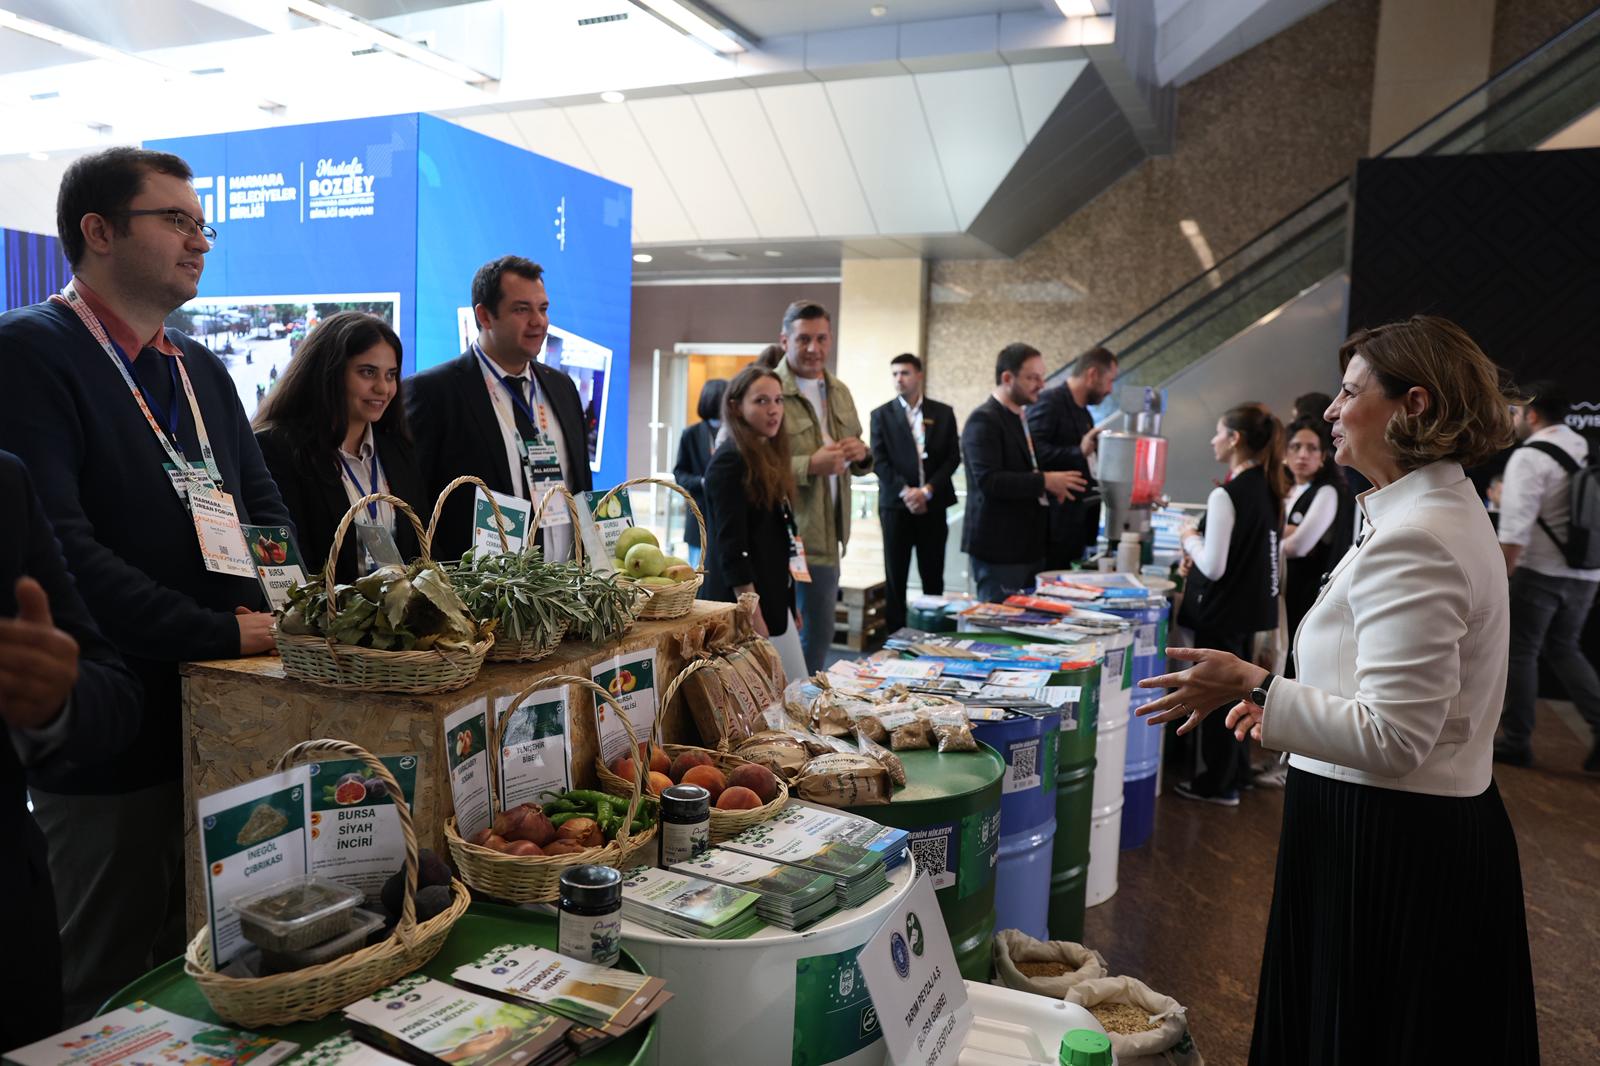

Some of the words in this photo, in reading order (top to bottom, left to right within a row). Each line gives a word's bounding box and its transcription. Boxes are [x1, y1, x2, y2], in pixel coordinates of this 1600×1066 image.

[229, 173, 285, 190] MARMARA
[309, 175, 375, 197] BOZBEY
[229, 187, 297, 205] BELEDİYELER
[229, 201, 265, 220] BİRLİĞİ
[193, 496, 222, 508] MARMARA
[194, 502, 214, 513] URBAN
[214, 507, 235, 517] FORUM
[1270, 529, 1280, 597] Volunteer
[267, 568, 286, 577] BURSA
[338, 808, 376, 821] BURSA
[339, 822, 373, 836] SİYAH
[907, 829, 927, 841] BENİM
[247, 842, 278, 861] İNEGÖL
[337, 836, 373, 850] İNCİRİ
[243, 853, 284, 878] ÇIBRIKASI
[539, 969, 571, 992] HİZMETİ
[905, 1002, 920, 1028] TARIM
[917, 978, 935, 1007] PEYZAJ
[398, 1018, 430, 1034] MOBİL
[428, 998, 465, 1019] TOPRAK
[408, 1019, 443, 1041] ANALİZ
[441, 1001, 480, 1022] HİZMETİ
